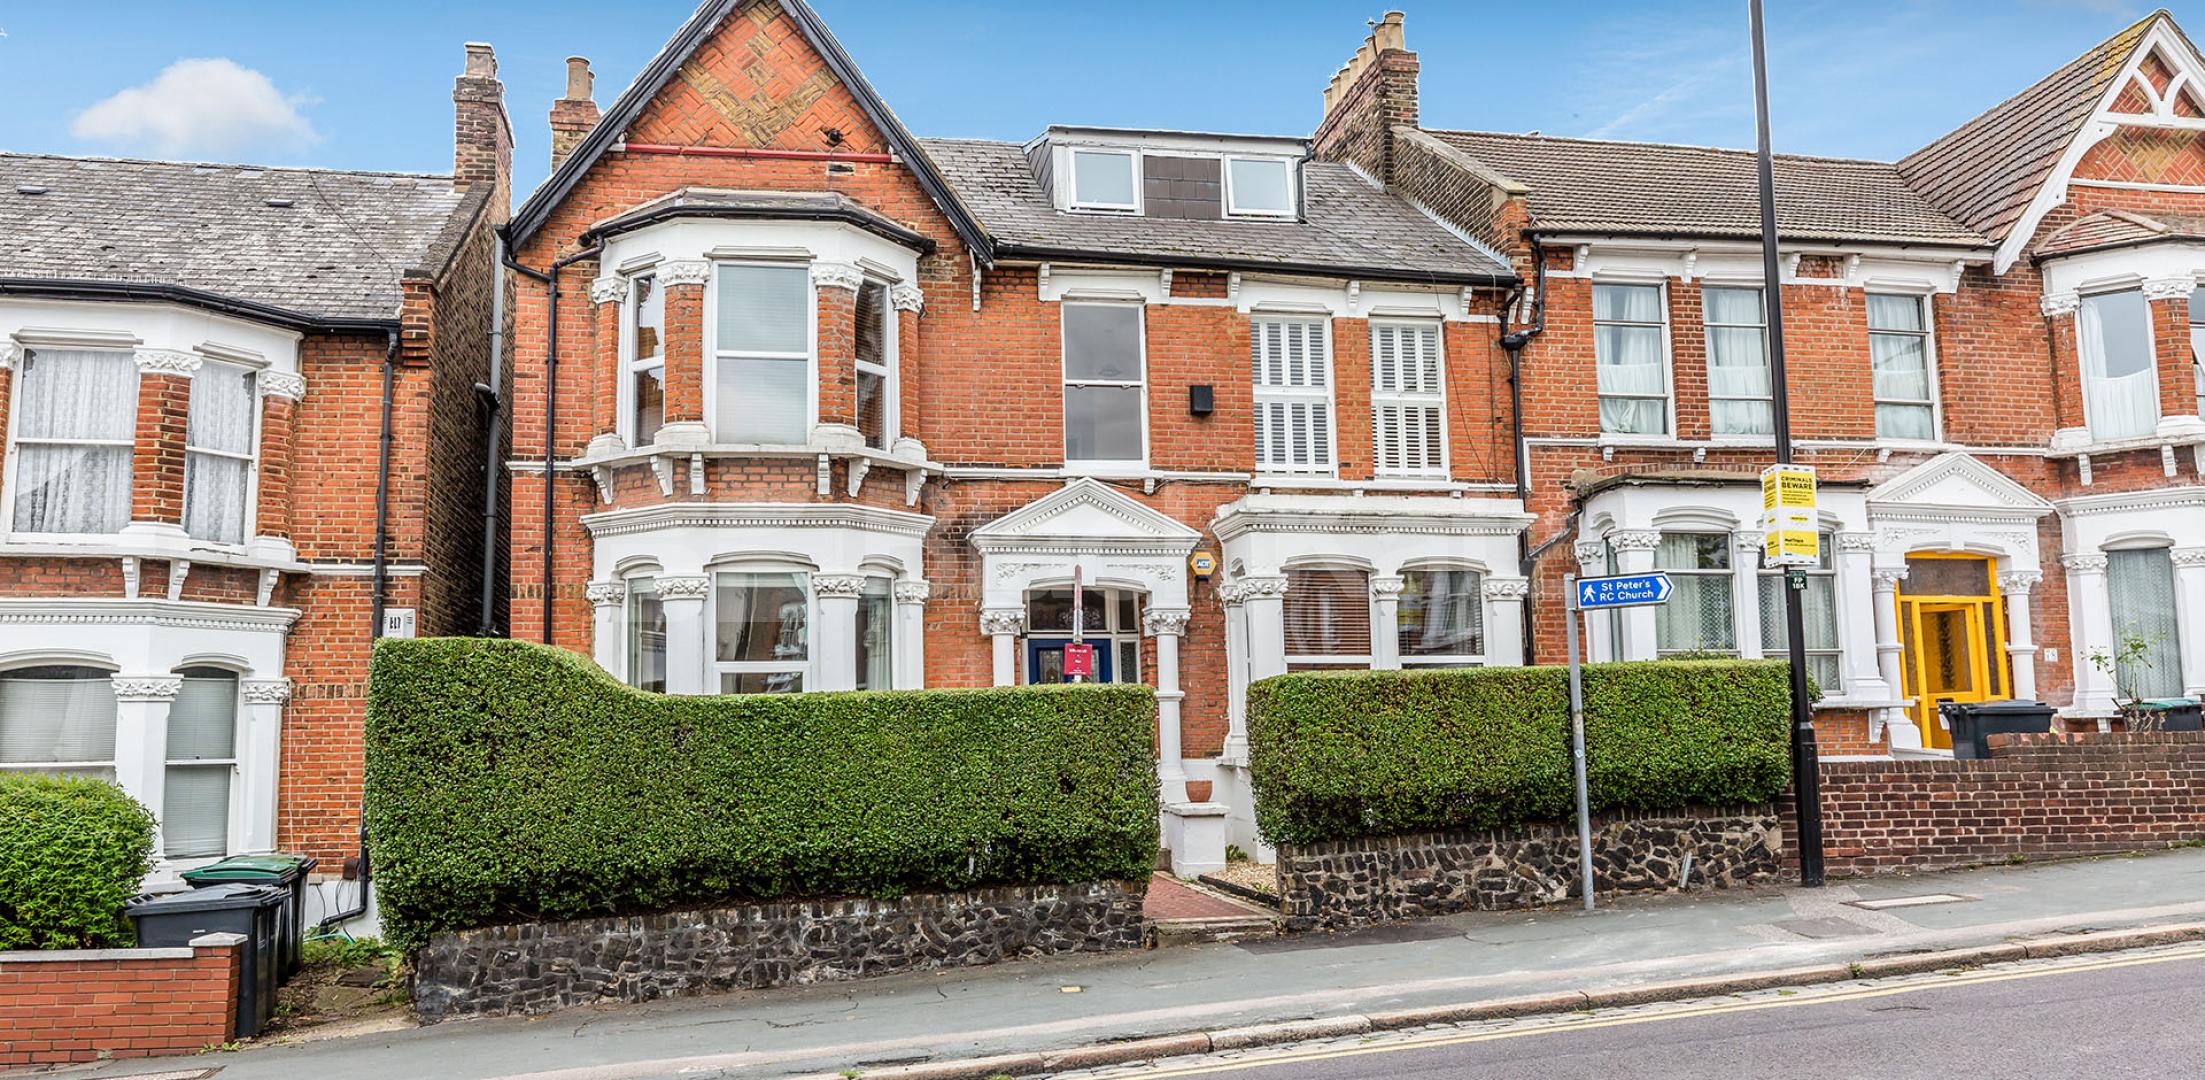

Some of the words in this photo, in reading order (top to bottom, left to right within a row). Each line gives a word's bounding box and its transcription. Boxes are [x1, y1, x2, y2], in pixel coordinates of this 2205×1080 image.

[1781, 482, 1812, 490] BEWARE
[1601, 582, 1613, 591] St
[1616, 579, 1651, 590] Peter's
[1600, 592, 1615, 601] RC
[1617, 589, 1654, 600] Church
